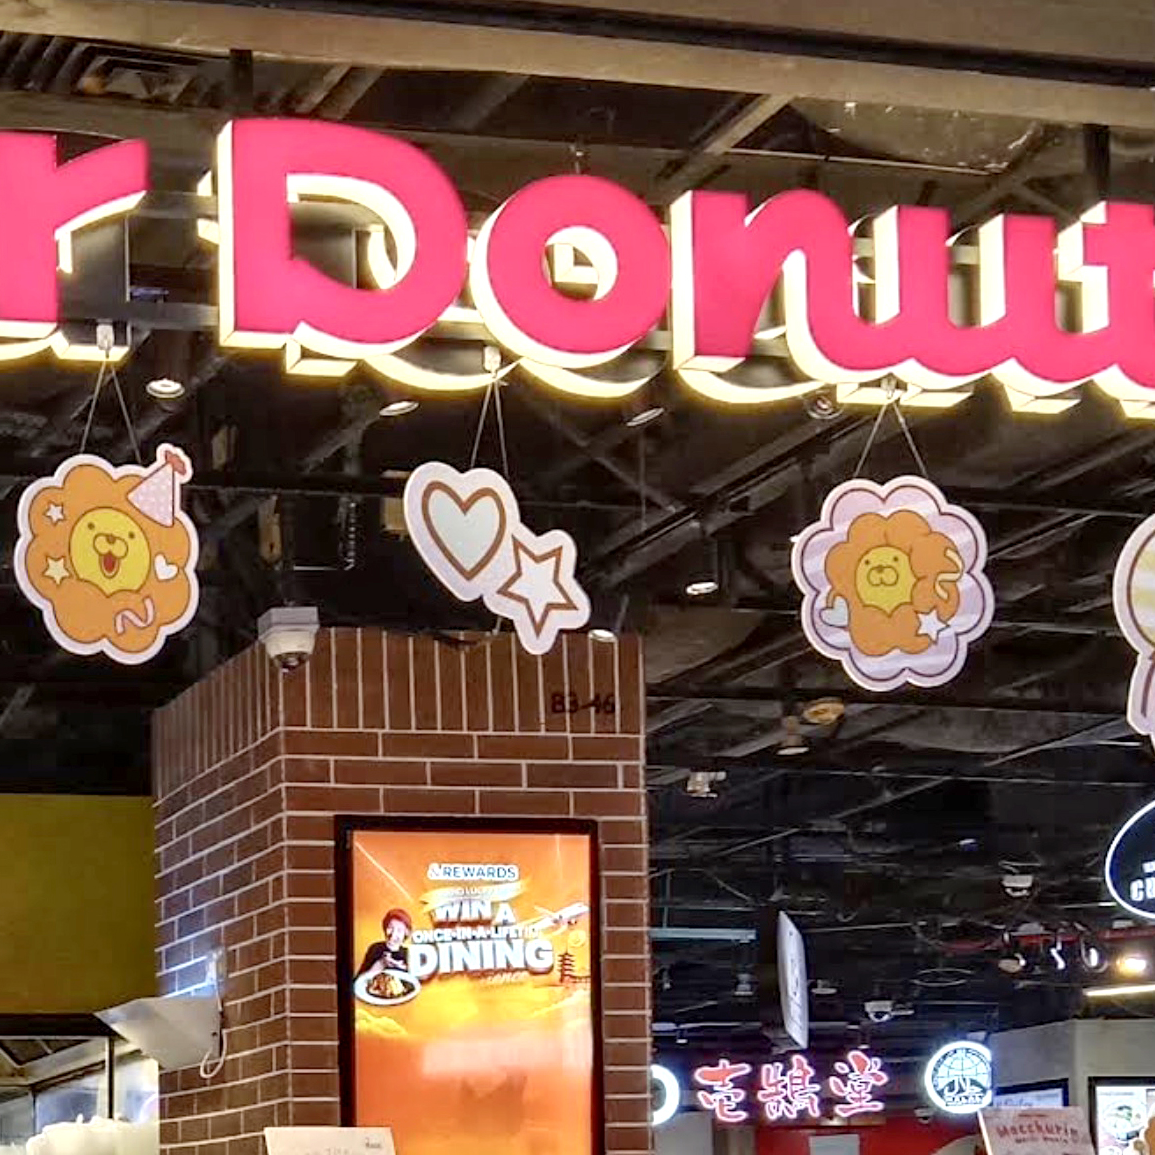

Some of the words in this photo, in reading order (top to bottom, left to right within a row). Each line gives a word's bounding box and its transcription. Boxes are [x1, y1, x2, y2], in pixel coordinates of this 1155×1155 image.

[434, 899, 492, 921] WIN
[495, 902, 518, 925] A
[408, 939, 554, 978] DINING
